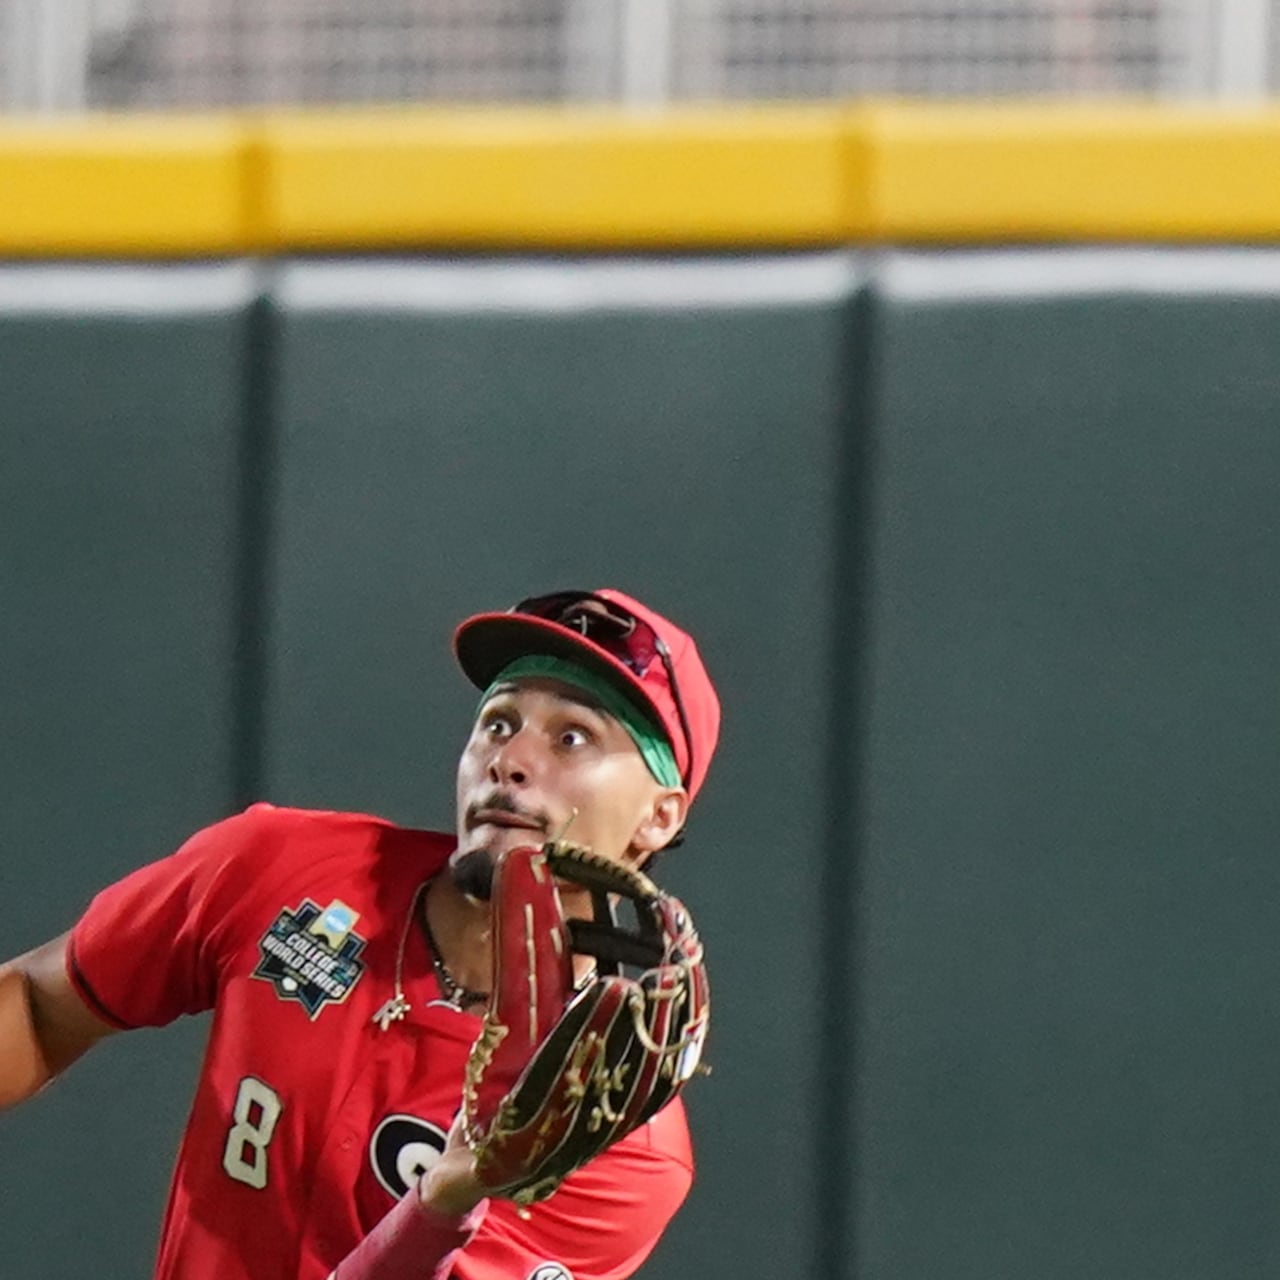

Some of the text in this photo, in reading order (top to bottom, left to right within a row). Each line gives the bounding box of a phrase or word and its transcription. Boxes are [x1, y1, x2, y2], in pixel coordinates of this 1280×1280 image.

[262, 934, 306, 970] WORLD
[299, 961, 347, 998] SERIES
[285, 933, 340, 974] COLLEGE
[223, 1077, 282, 1190] 8
